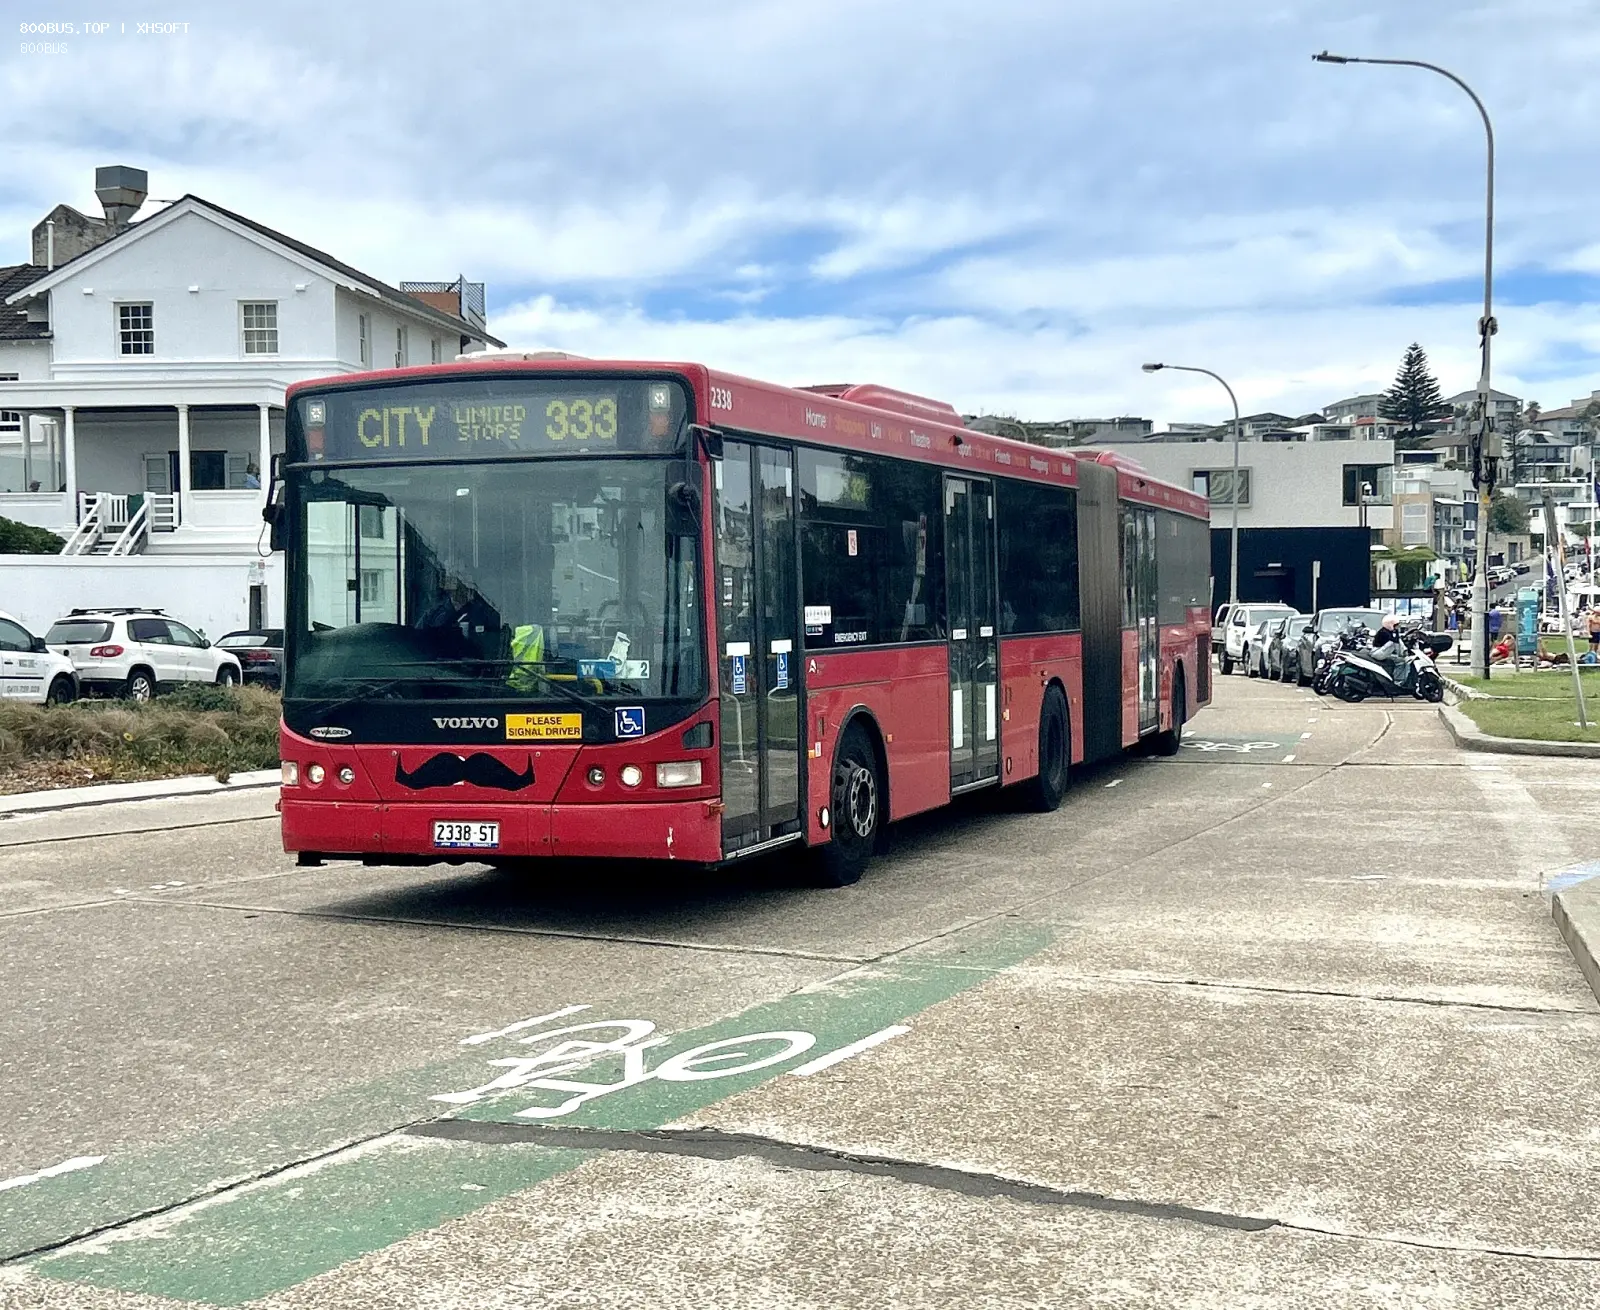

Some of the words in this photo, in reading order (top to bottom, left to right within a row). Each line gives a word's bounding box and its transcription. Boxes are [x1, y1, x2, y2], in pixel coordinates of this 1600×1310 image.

[711, 386, 732, 411] 2338
[455, 405, 526, 424] LIMITED
[546, 398, 617, 441] 333
[805, 407, 827, 429] Home
[871, 422, 882, 438] Uni
[357, 406, 435, 447] CITY
[458, 423, 521, 442] STOPS
[640, 661, 648, 677] 2
[433, 717, 499, 729] VOLVO
[526, 716, 562, 726] PLEASE
[508, 727, 542, 737] SIGNAL
[545, 727, 581, 736] DRIVER
